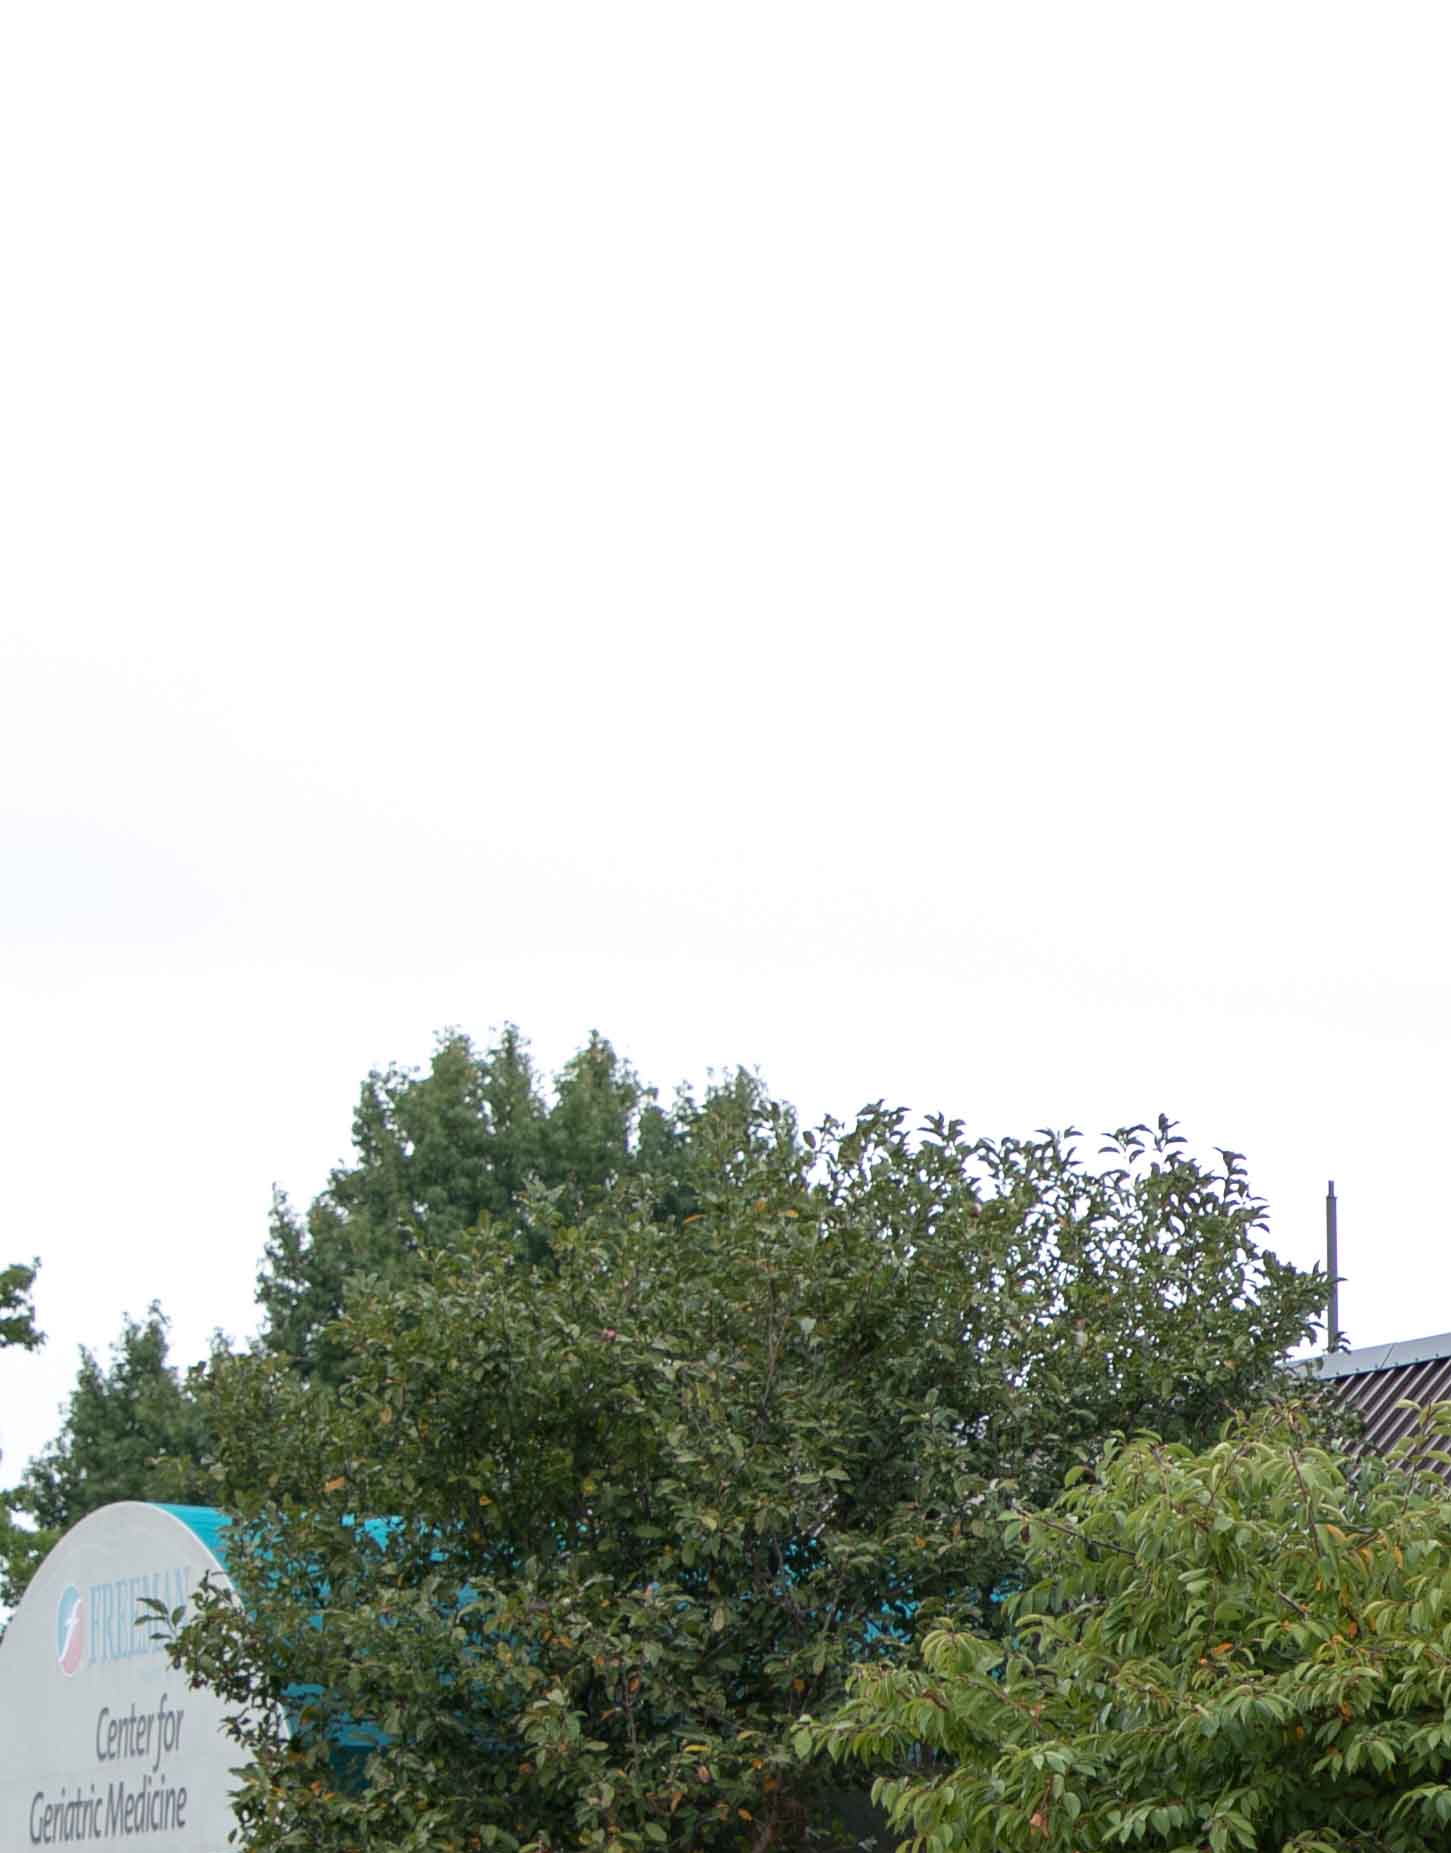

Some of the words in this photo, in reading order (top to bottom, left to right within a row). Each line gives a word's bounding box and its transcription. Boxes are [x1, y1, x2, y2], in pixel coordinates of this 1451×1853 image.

[96, 1701, 154, 1762] Center
[151, 1693, 184, 1769] for
[30, 1783, 102, 1845] Geriatric
[104, 1776, 188, 1836] Medicine
